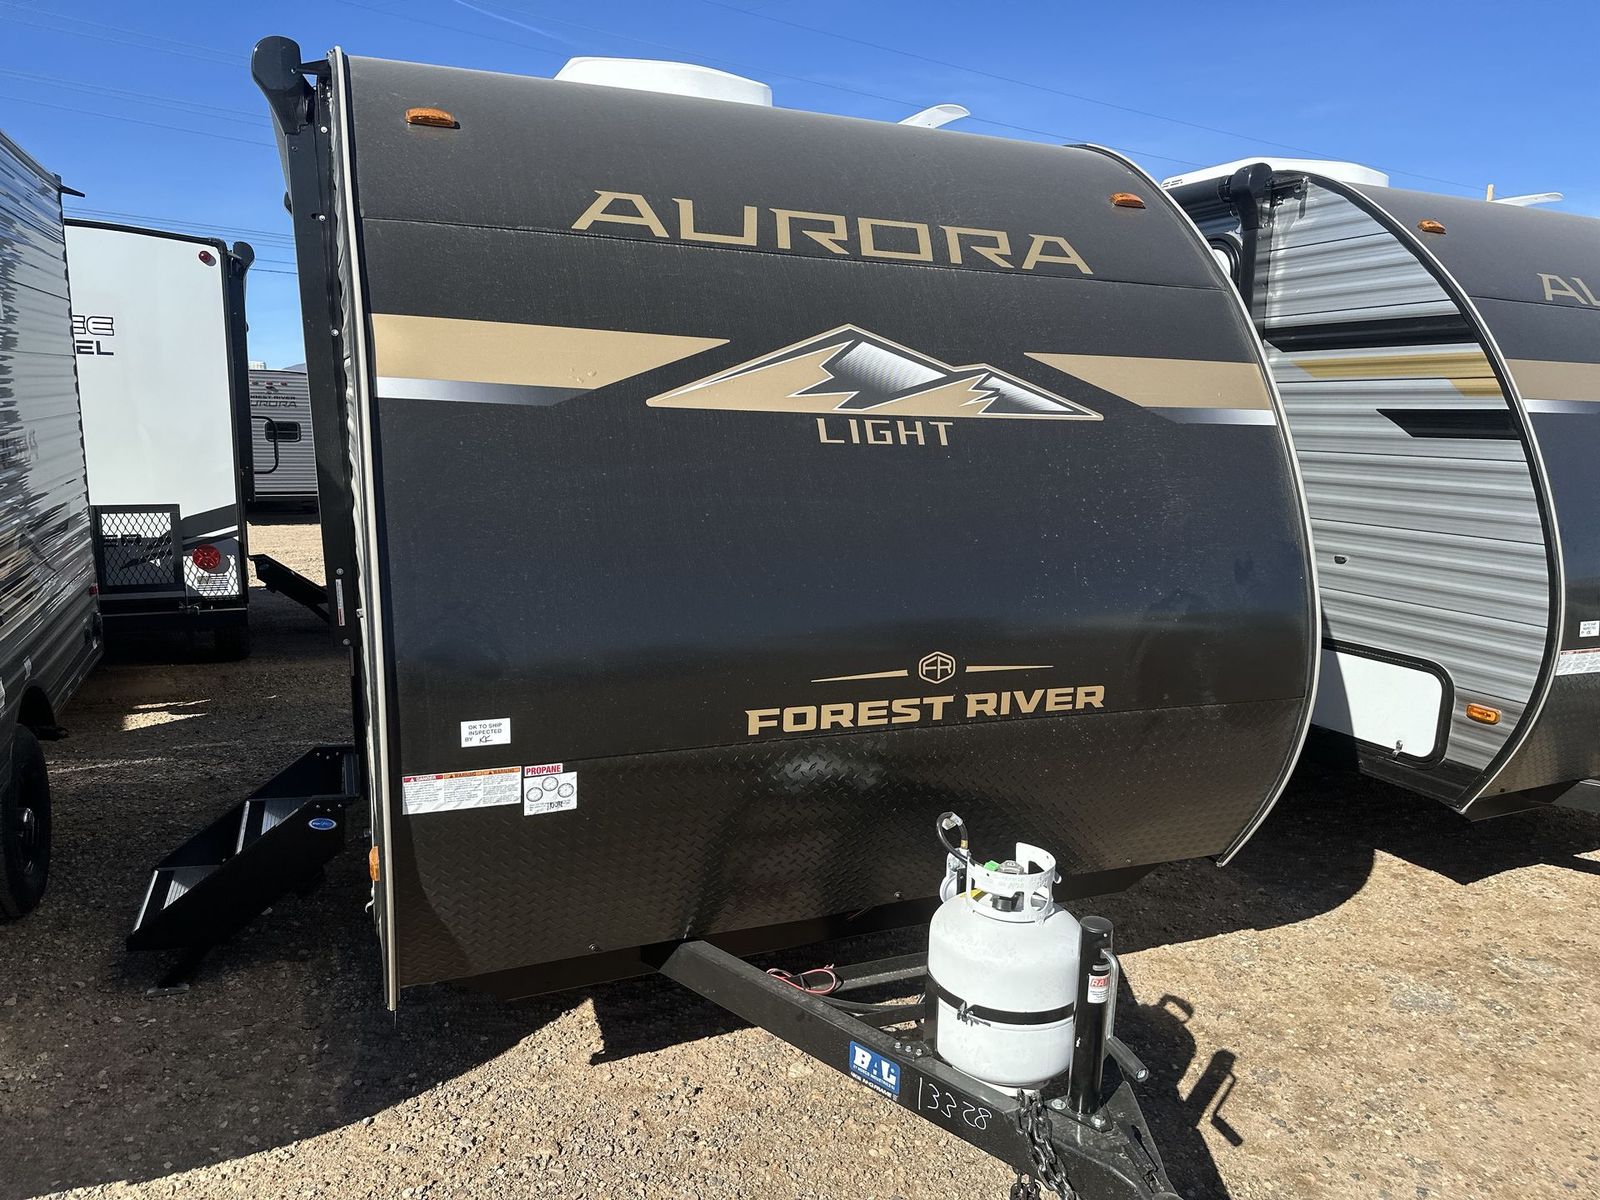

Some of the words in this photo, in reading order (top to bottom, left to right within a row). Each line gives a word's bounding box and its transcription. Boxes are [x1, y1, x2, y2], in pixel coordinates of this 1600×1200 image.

[571, 189, 1094, 275] AURORA
[816, 418, 954, 446] LIGHT
[745, 695, 955, 736] FOREST
[965, 685, 1106, 718] RIVER
[525, 764, 562, 776] PROPANE
